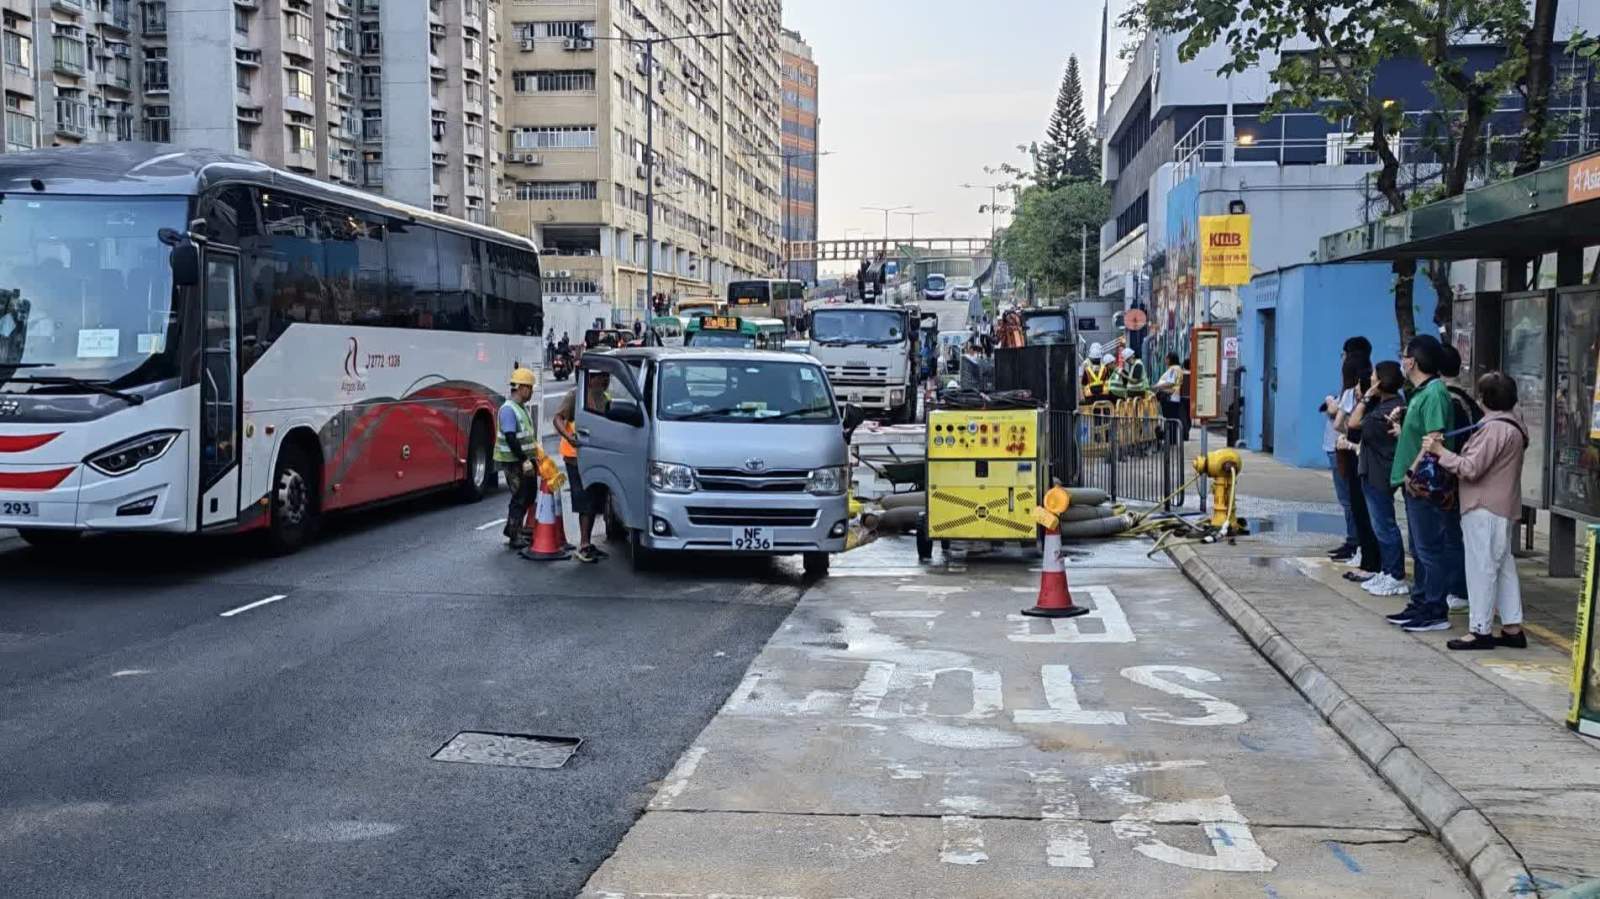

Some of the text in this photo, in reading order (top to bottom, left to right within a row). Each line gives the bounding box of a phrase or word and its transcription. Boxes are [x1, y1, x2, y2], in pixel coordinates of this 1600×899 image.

[1210, 232, 1241, 247] KMB
[3, 502, 31, 515] 293
[744, 527, 762, 538] NF
[735, 538, 770, 549] 9236
